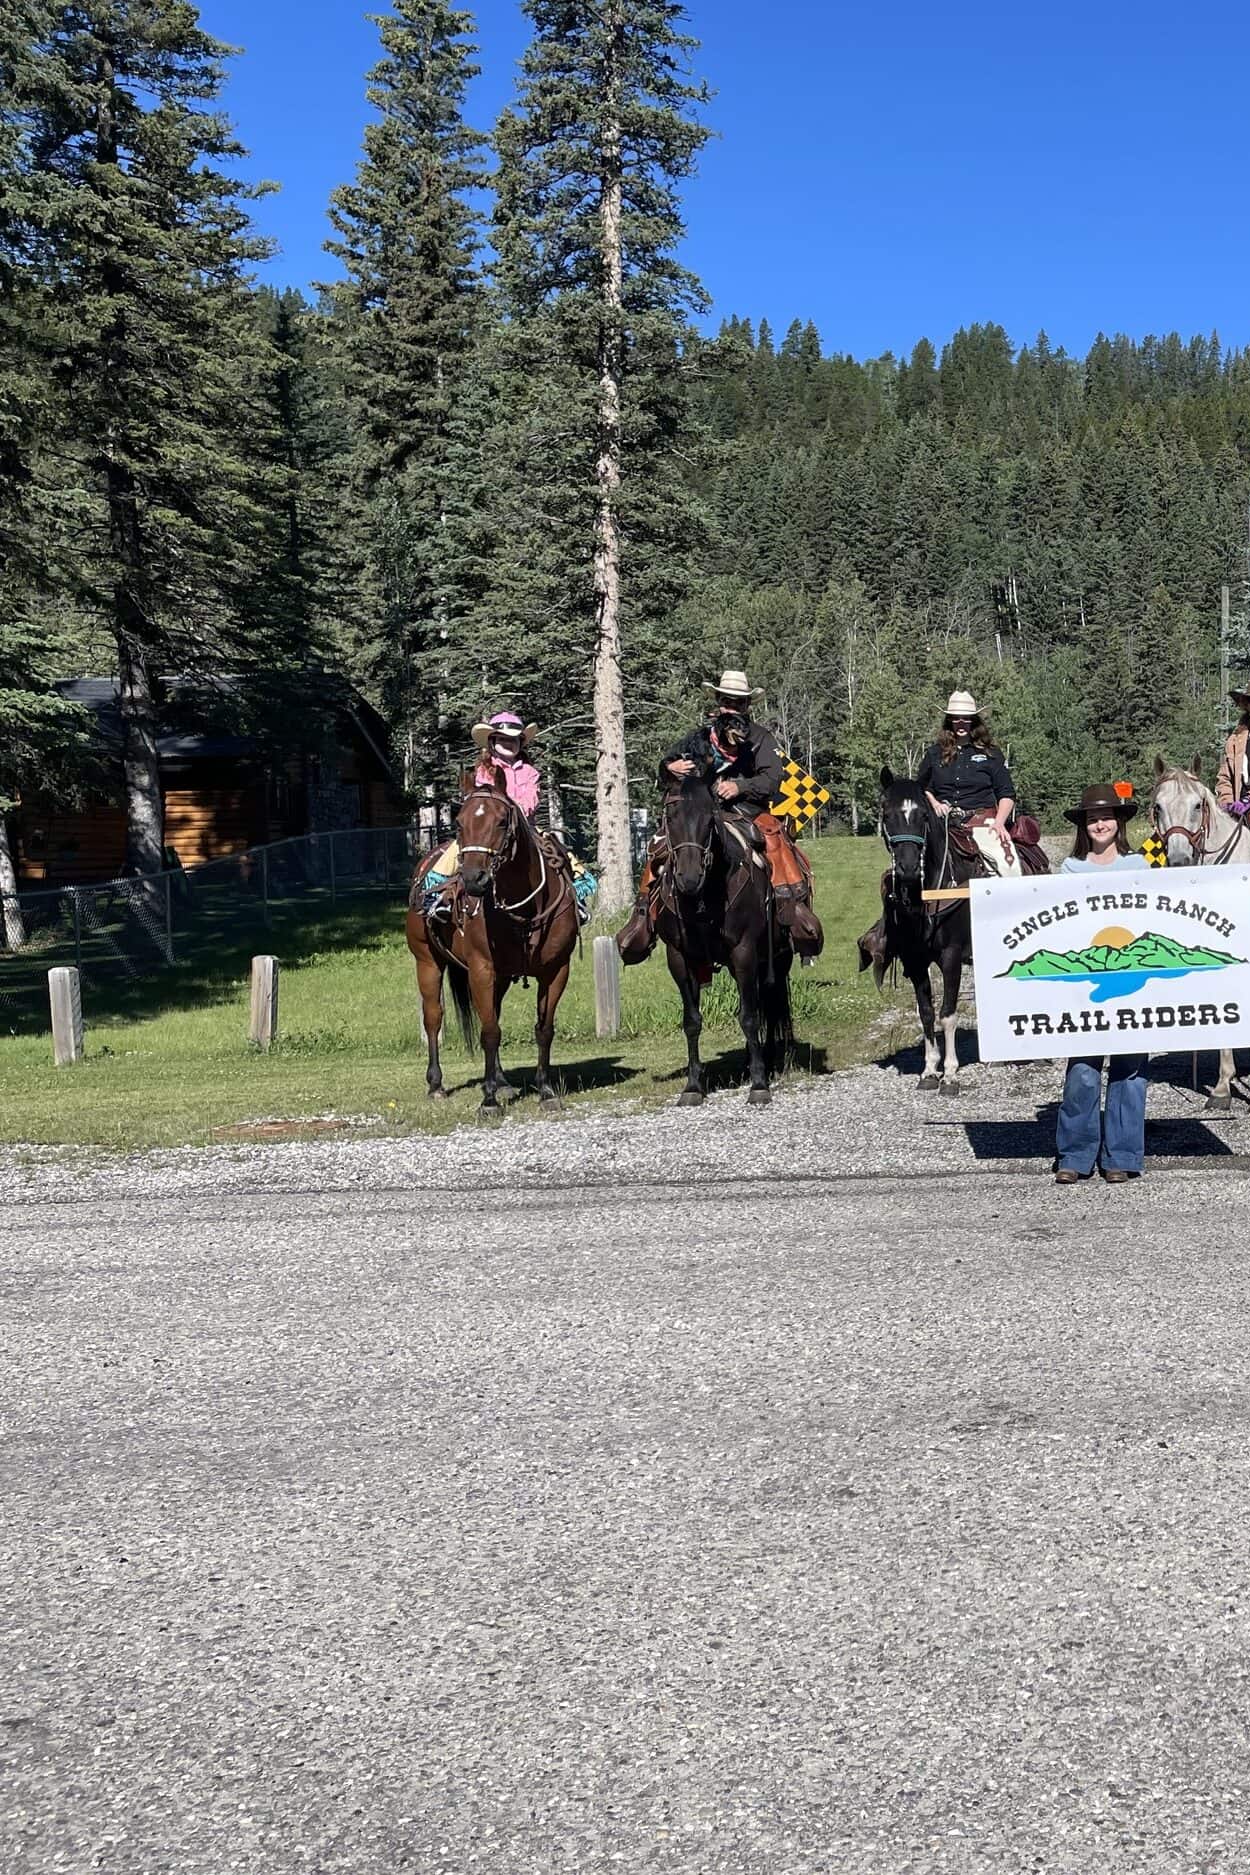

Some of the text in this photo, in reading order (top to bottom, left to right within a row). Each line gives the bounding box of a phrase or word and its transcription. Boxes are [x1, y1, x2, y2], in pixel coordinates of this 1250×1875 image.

[1003, 893, 1236, 950] SINGLE TREE RANCH
[1009, 1003, 1241, 1036] TRAIL RIDERS
